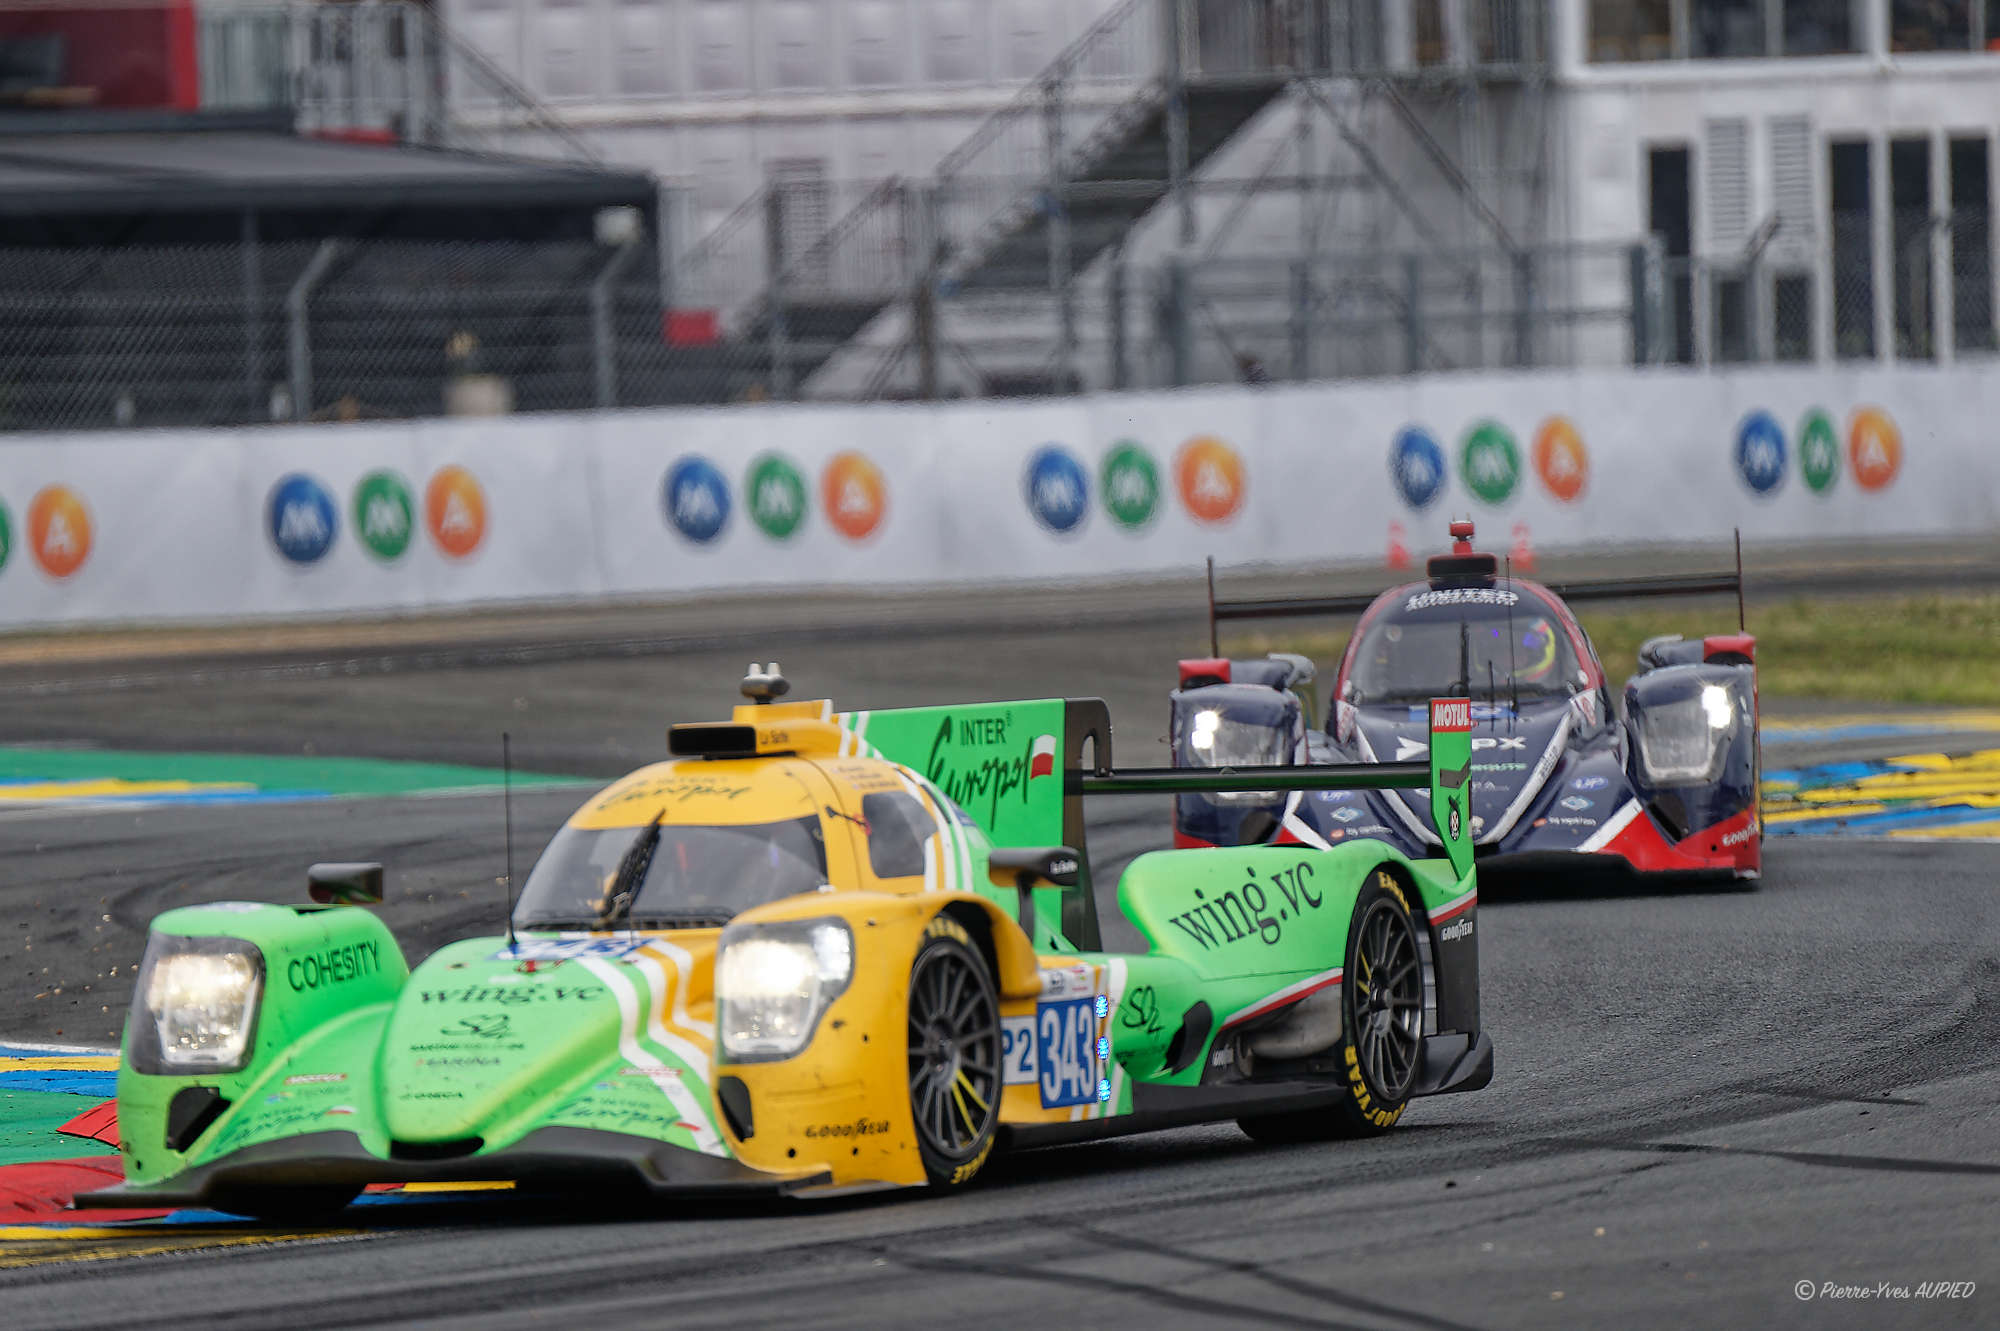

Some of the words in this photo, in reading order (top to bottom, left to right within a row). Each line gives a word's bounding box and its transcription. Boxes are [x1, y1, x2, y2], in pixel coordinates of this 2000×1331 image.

[1434, 703, 1469, 727] MOTUL
[960, 718, 1006, 746] INTER
[1169, 861, 1322, 951] wing.vc
[1442, 919, 1473, 941] GOODYEAR
[288, 939, 380, 992] COHESITY
[421, 984, 604, 1006] wing.vc
[1040, 1004, 1097, 1102] 343
